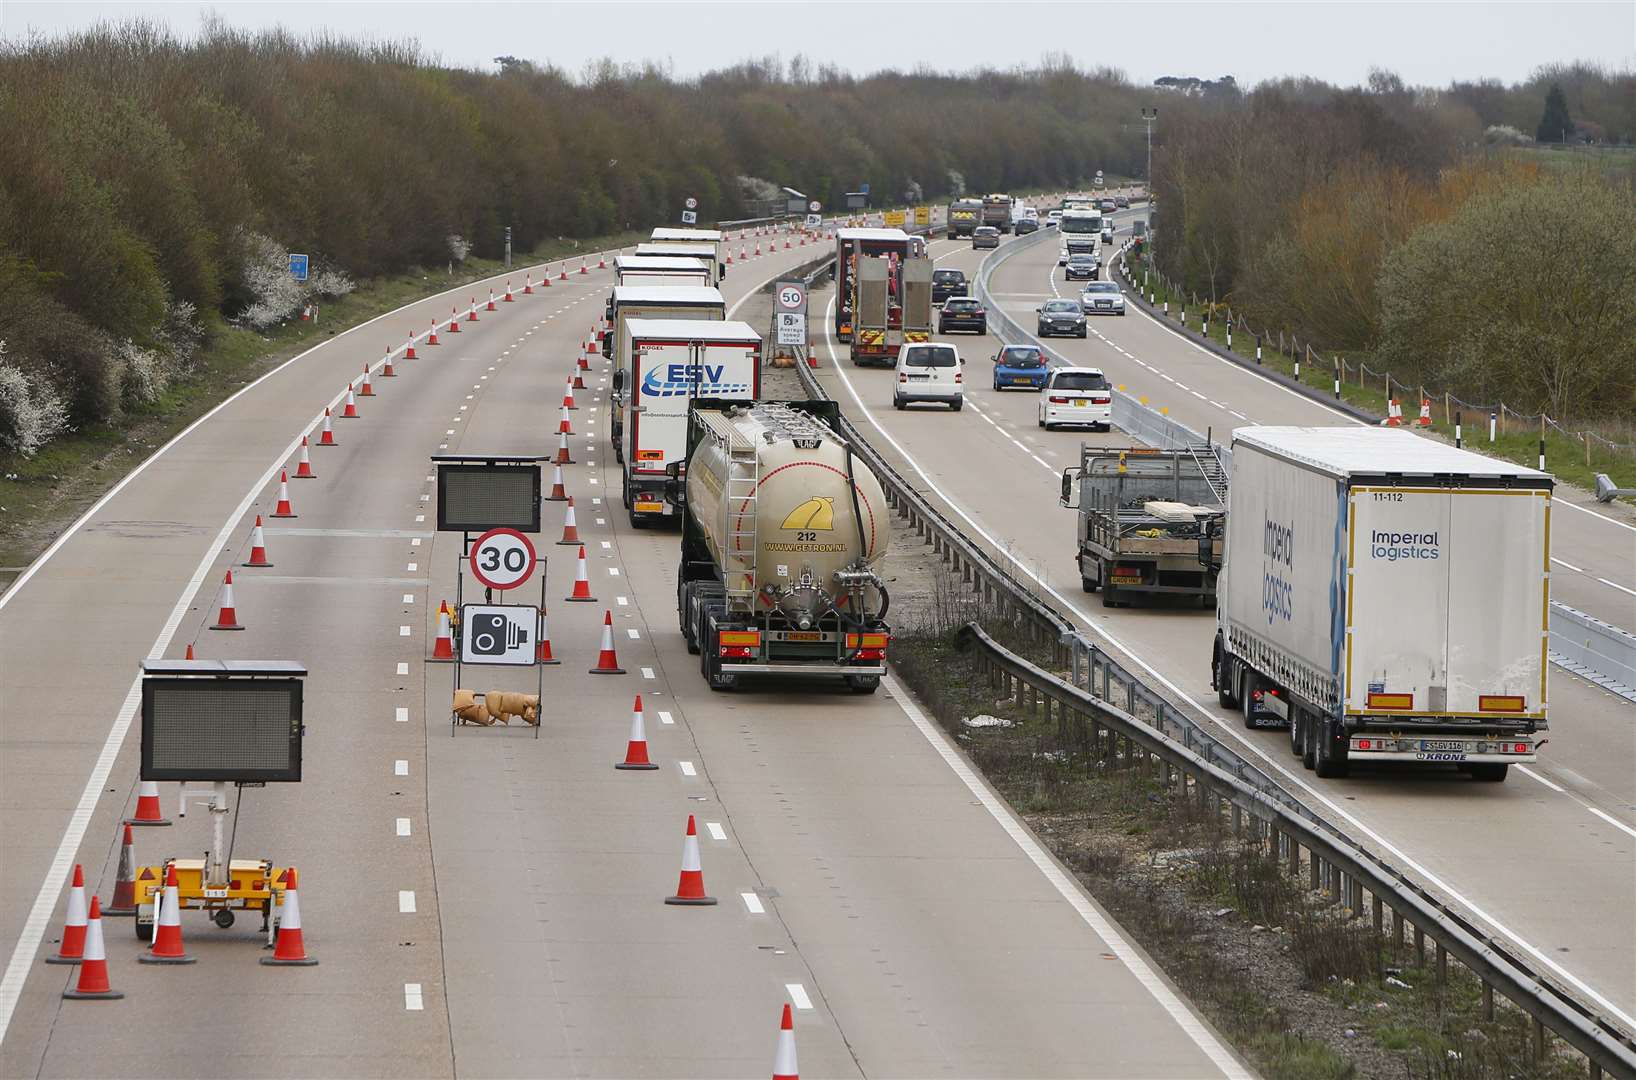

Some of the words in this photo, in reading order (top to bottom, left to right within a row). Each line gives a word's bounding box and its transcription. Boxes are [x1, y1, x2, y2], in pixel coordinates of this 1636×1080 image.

[782, 292, 800, 302] 50
[668, 364, 724, 383] ESV
[1373, 493, 1403, 502] 11-112
[797, 532, 816, 541] 212
[1264, 509, 1293, 572] Imperial
[1372, 530, 1439, 546] Imperial
[764, 543, 848, 553] WWW.GETRON.NL
[1372, 544, 1439, 561] logistics
[480, 546, 526, 572] 30
[1263, 566, 1292, 624] logistics
